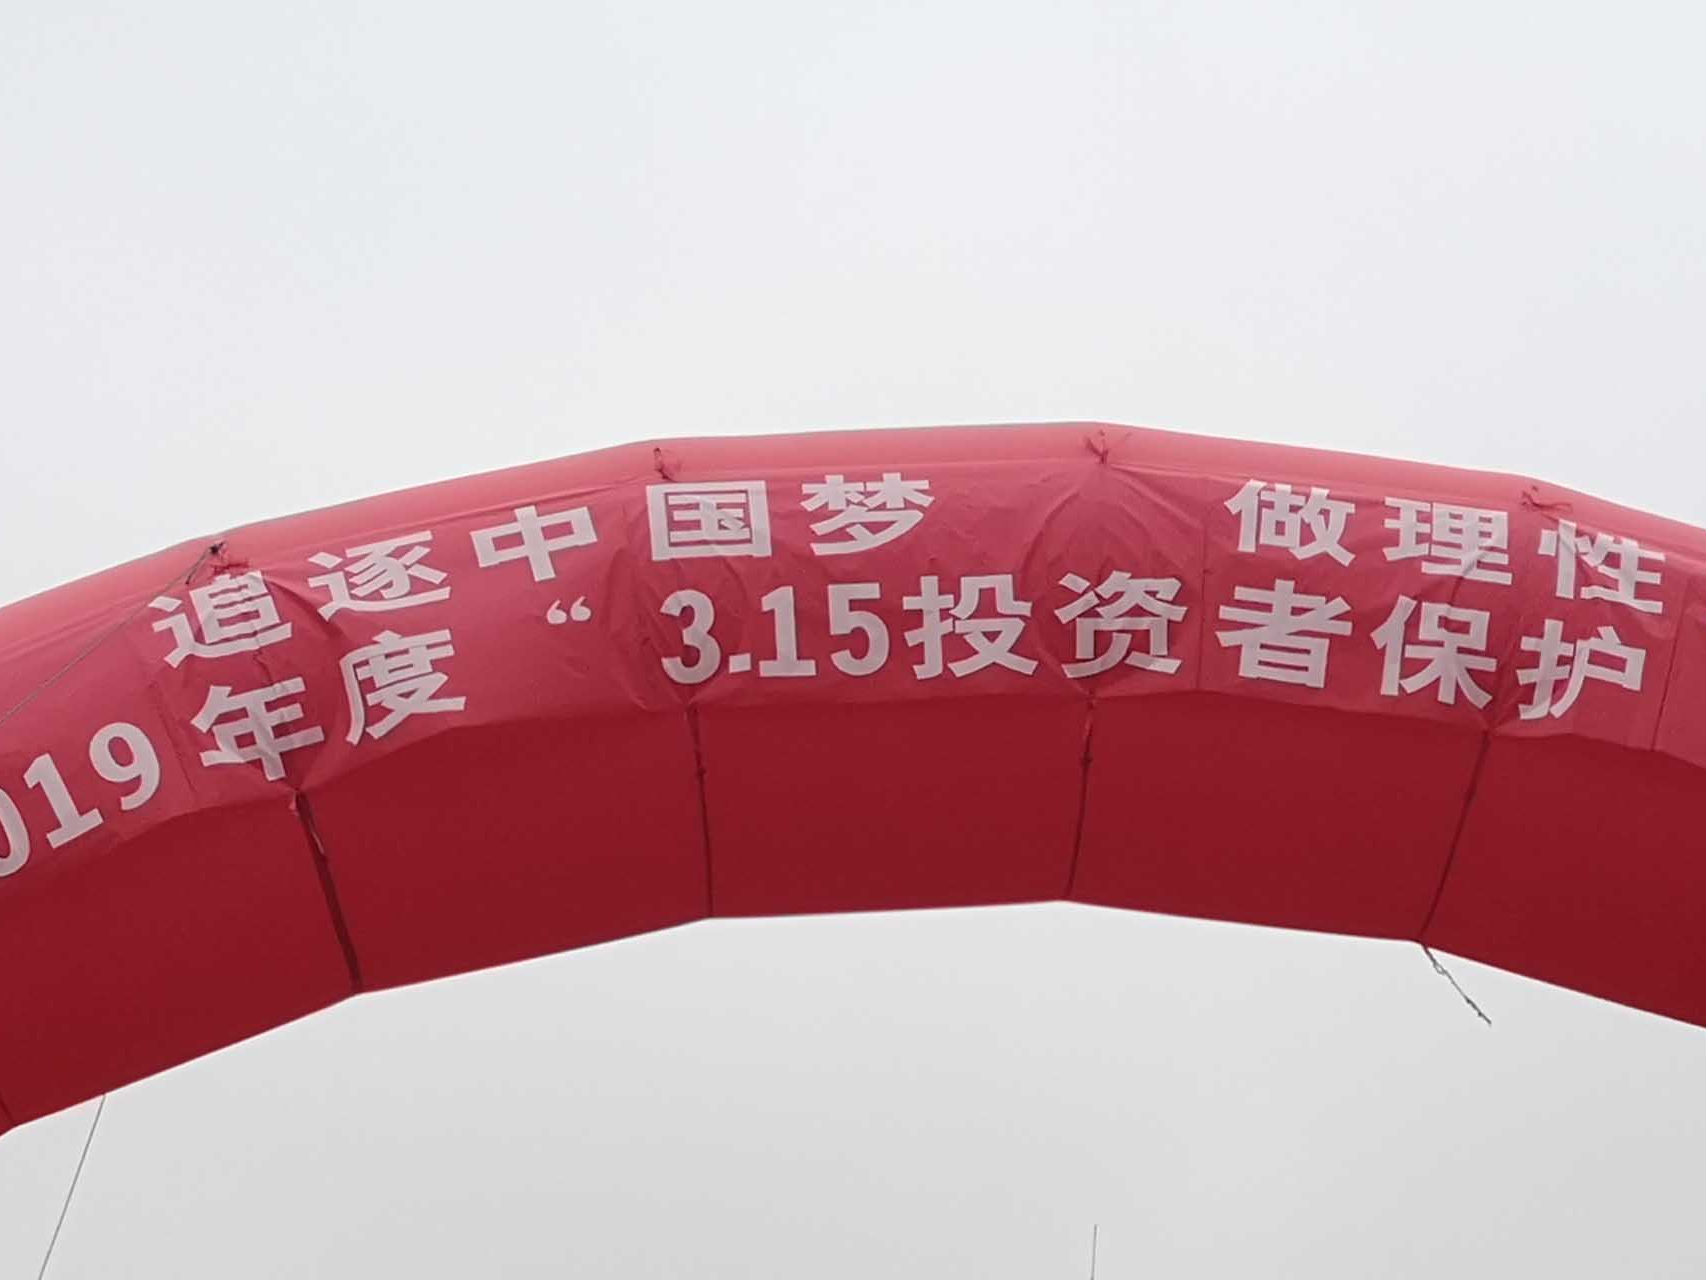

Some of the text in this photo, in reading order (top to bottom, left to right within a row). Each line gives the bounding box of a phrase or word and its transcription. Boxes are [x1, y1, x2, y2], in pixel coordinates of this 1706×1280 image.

[149, 471, 936, 668] 追逐中国梦
